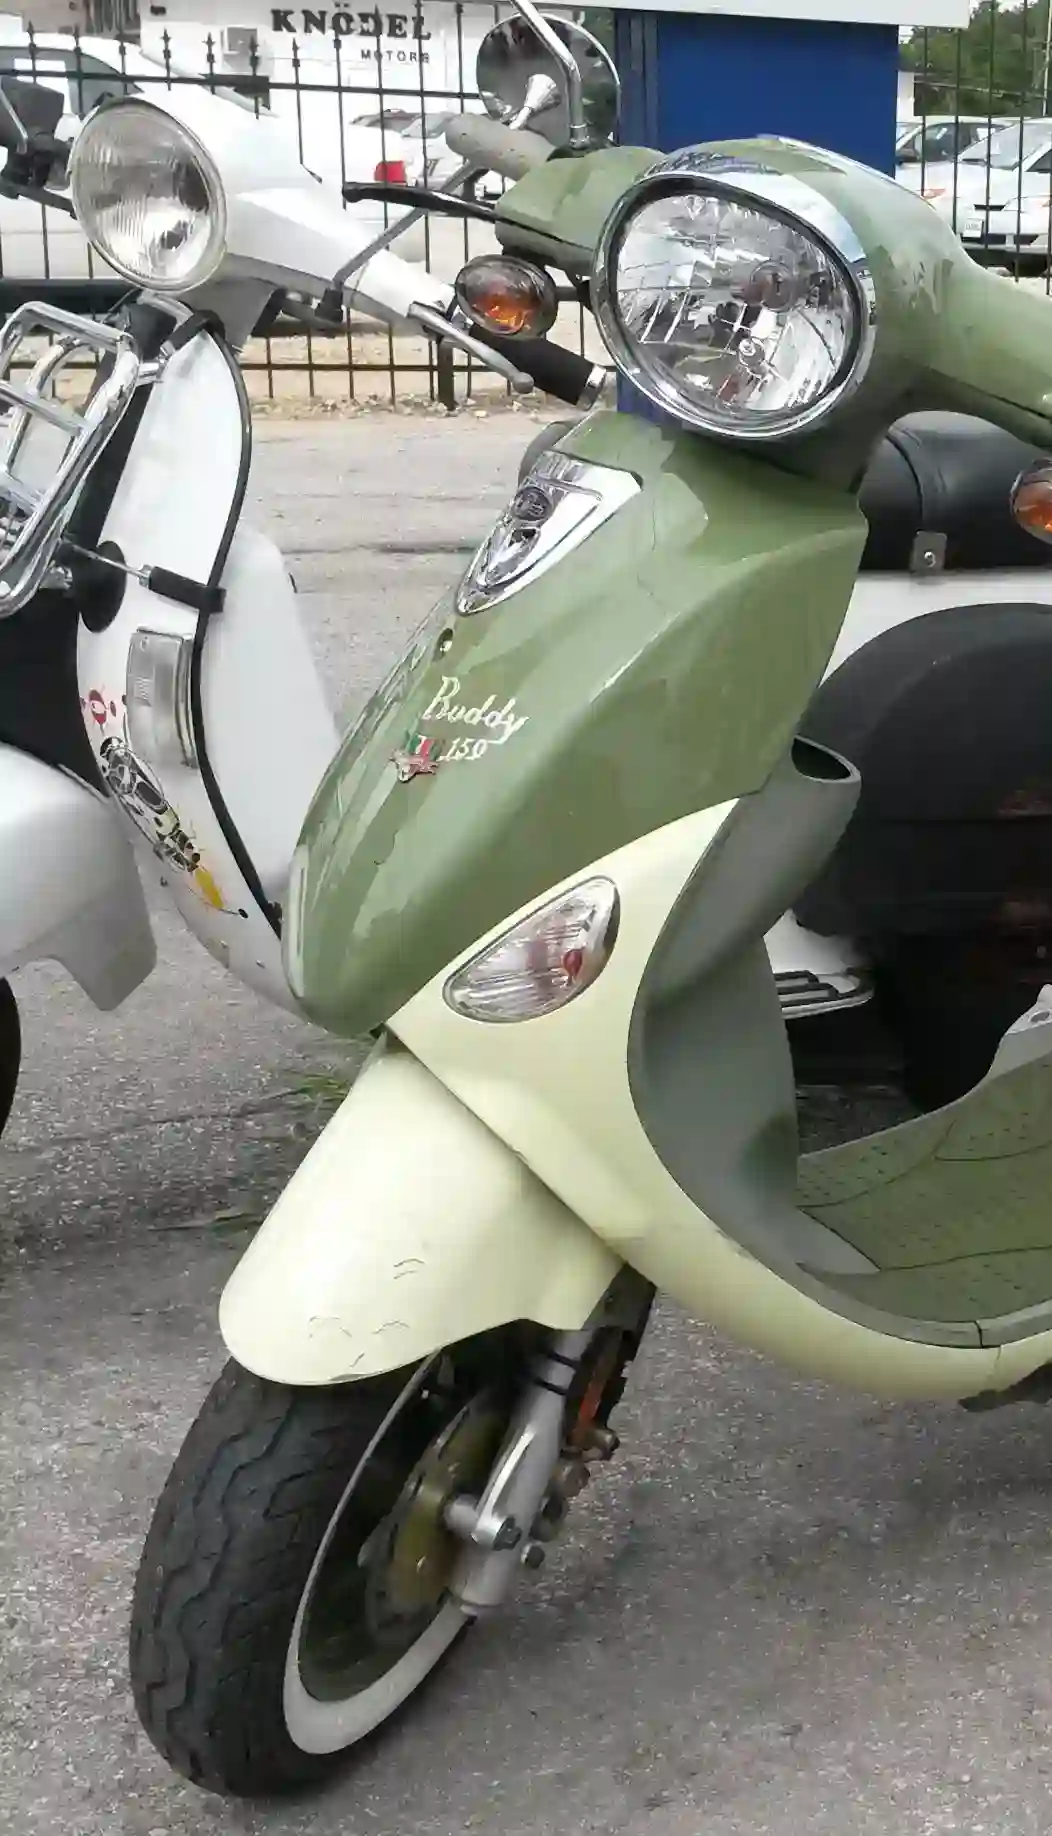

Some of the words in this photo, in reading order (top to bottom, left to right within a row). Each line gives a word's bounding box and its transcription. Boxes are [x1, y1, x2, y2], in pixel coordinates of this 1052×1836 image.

[271, 2, 431, 40] KNÖDEL
[361, 49, 430, 63] MOTORS
[421, 676, 530, 745] Buddy
[436, 737, 488, 762] 150
